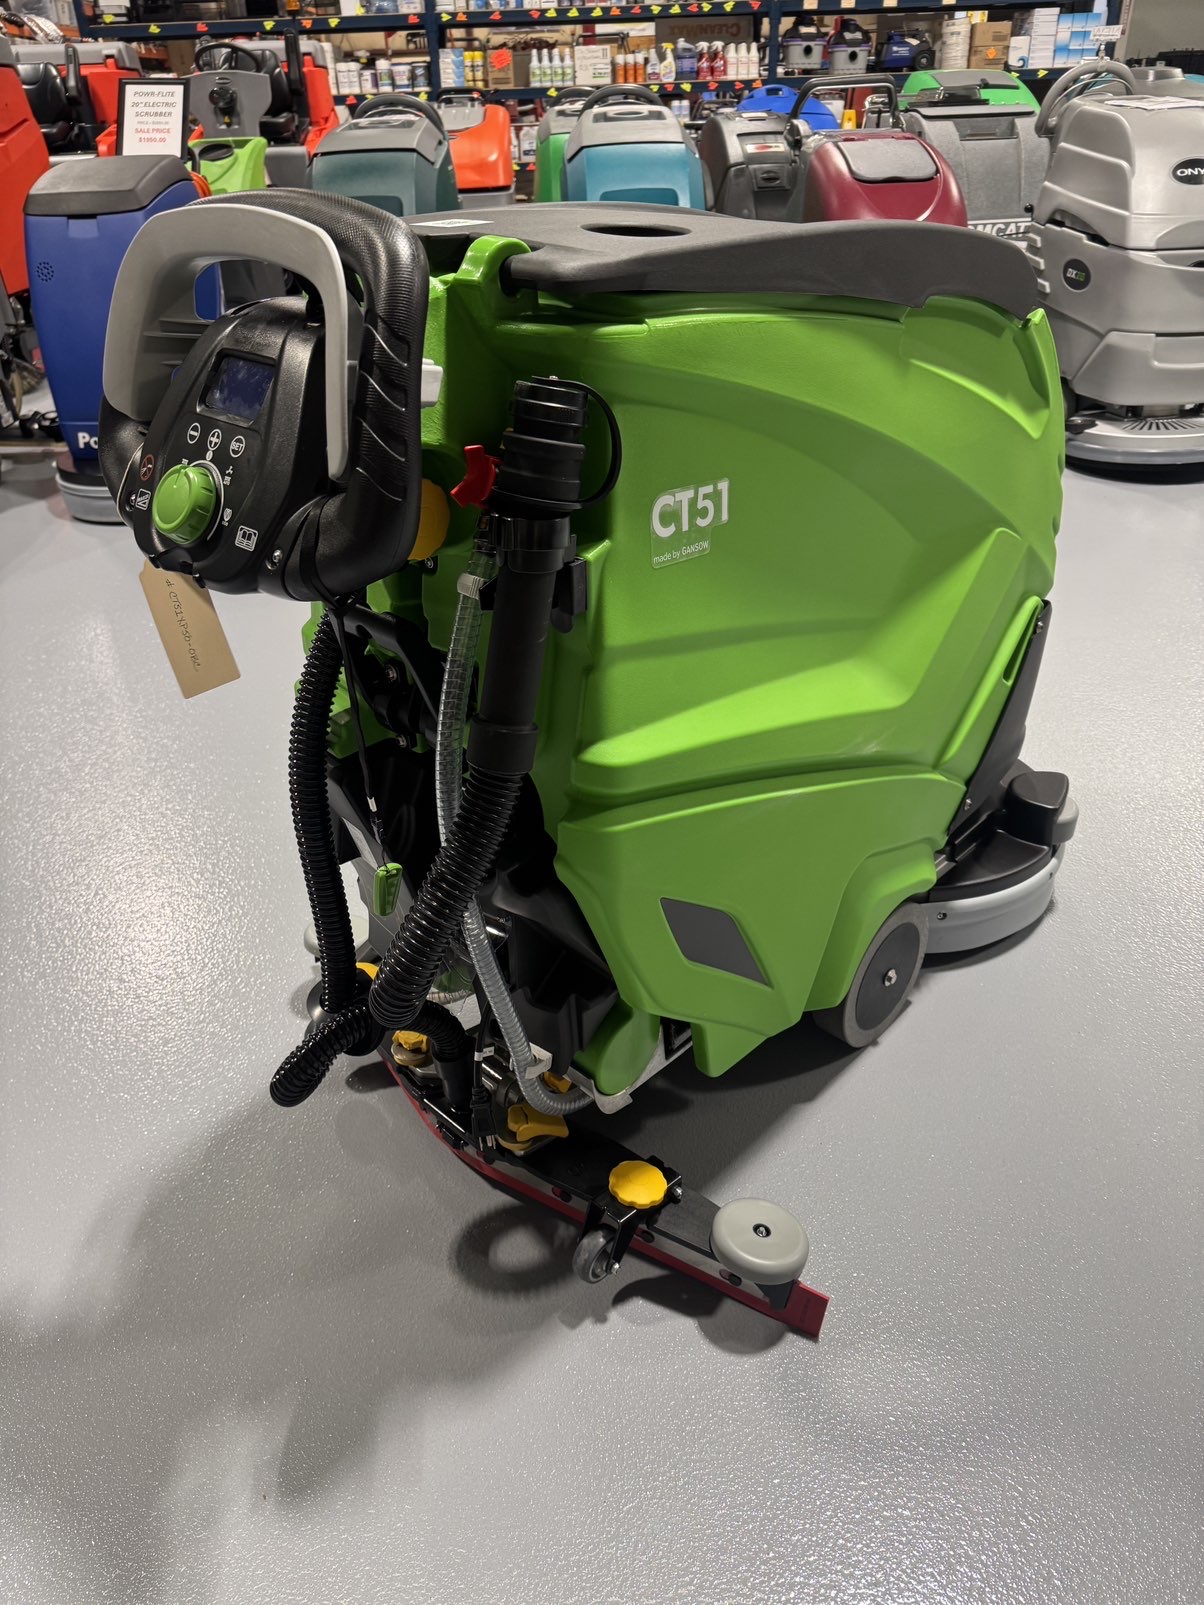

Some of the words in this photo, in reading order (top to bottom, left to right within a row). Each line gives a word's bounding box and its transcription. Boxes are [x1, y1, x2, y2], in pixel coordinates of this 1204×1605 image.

[231, 441, 244, 452] SET
[652, 482, 729, 538] CT51
[653, 552, 672, 564] made
[672, 550, 681, 559] by
[682, 541, 709, 555] GANSOW
